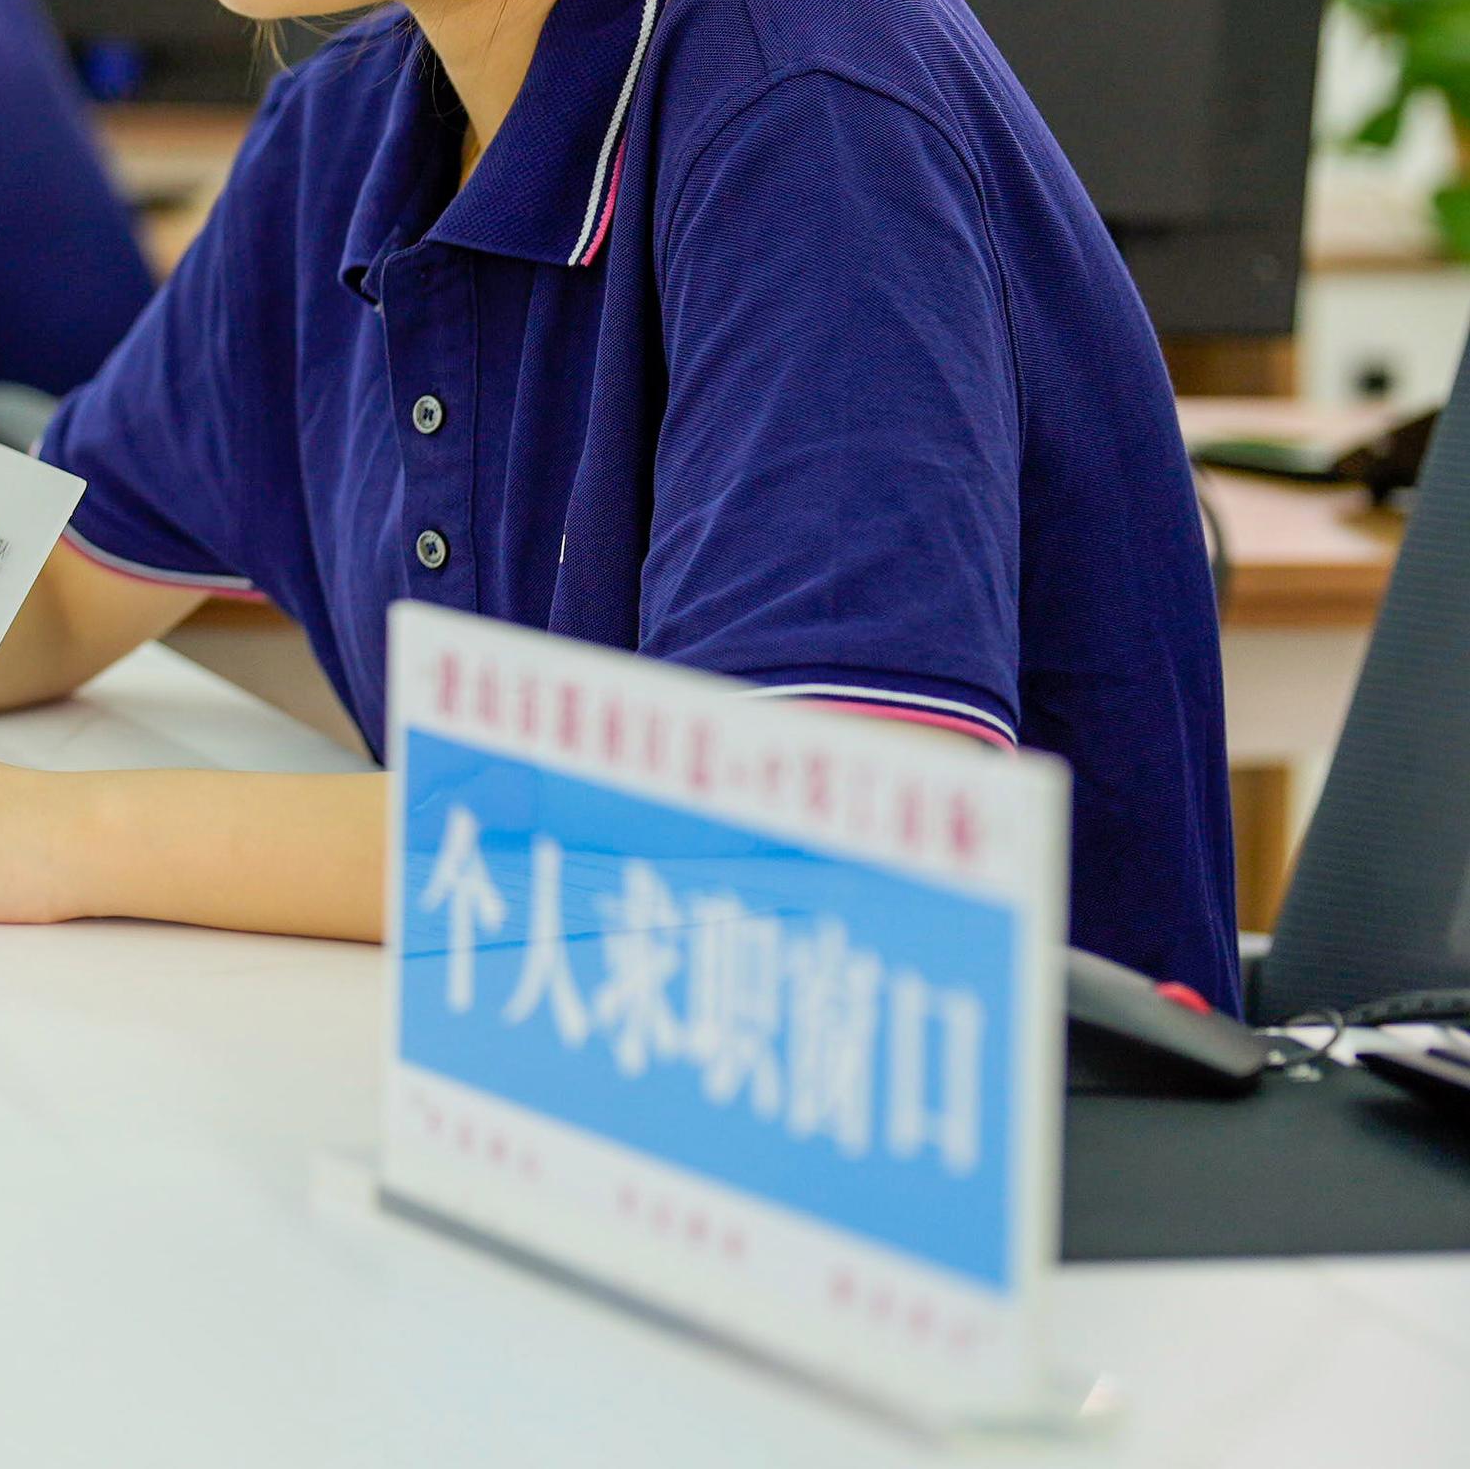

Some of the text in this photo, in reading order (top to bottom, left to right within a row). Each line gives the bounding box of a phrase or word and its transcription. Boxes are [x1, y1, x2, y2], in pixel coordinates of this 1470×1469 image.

[421, 806, 983, 1176] 个人求职窗口
